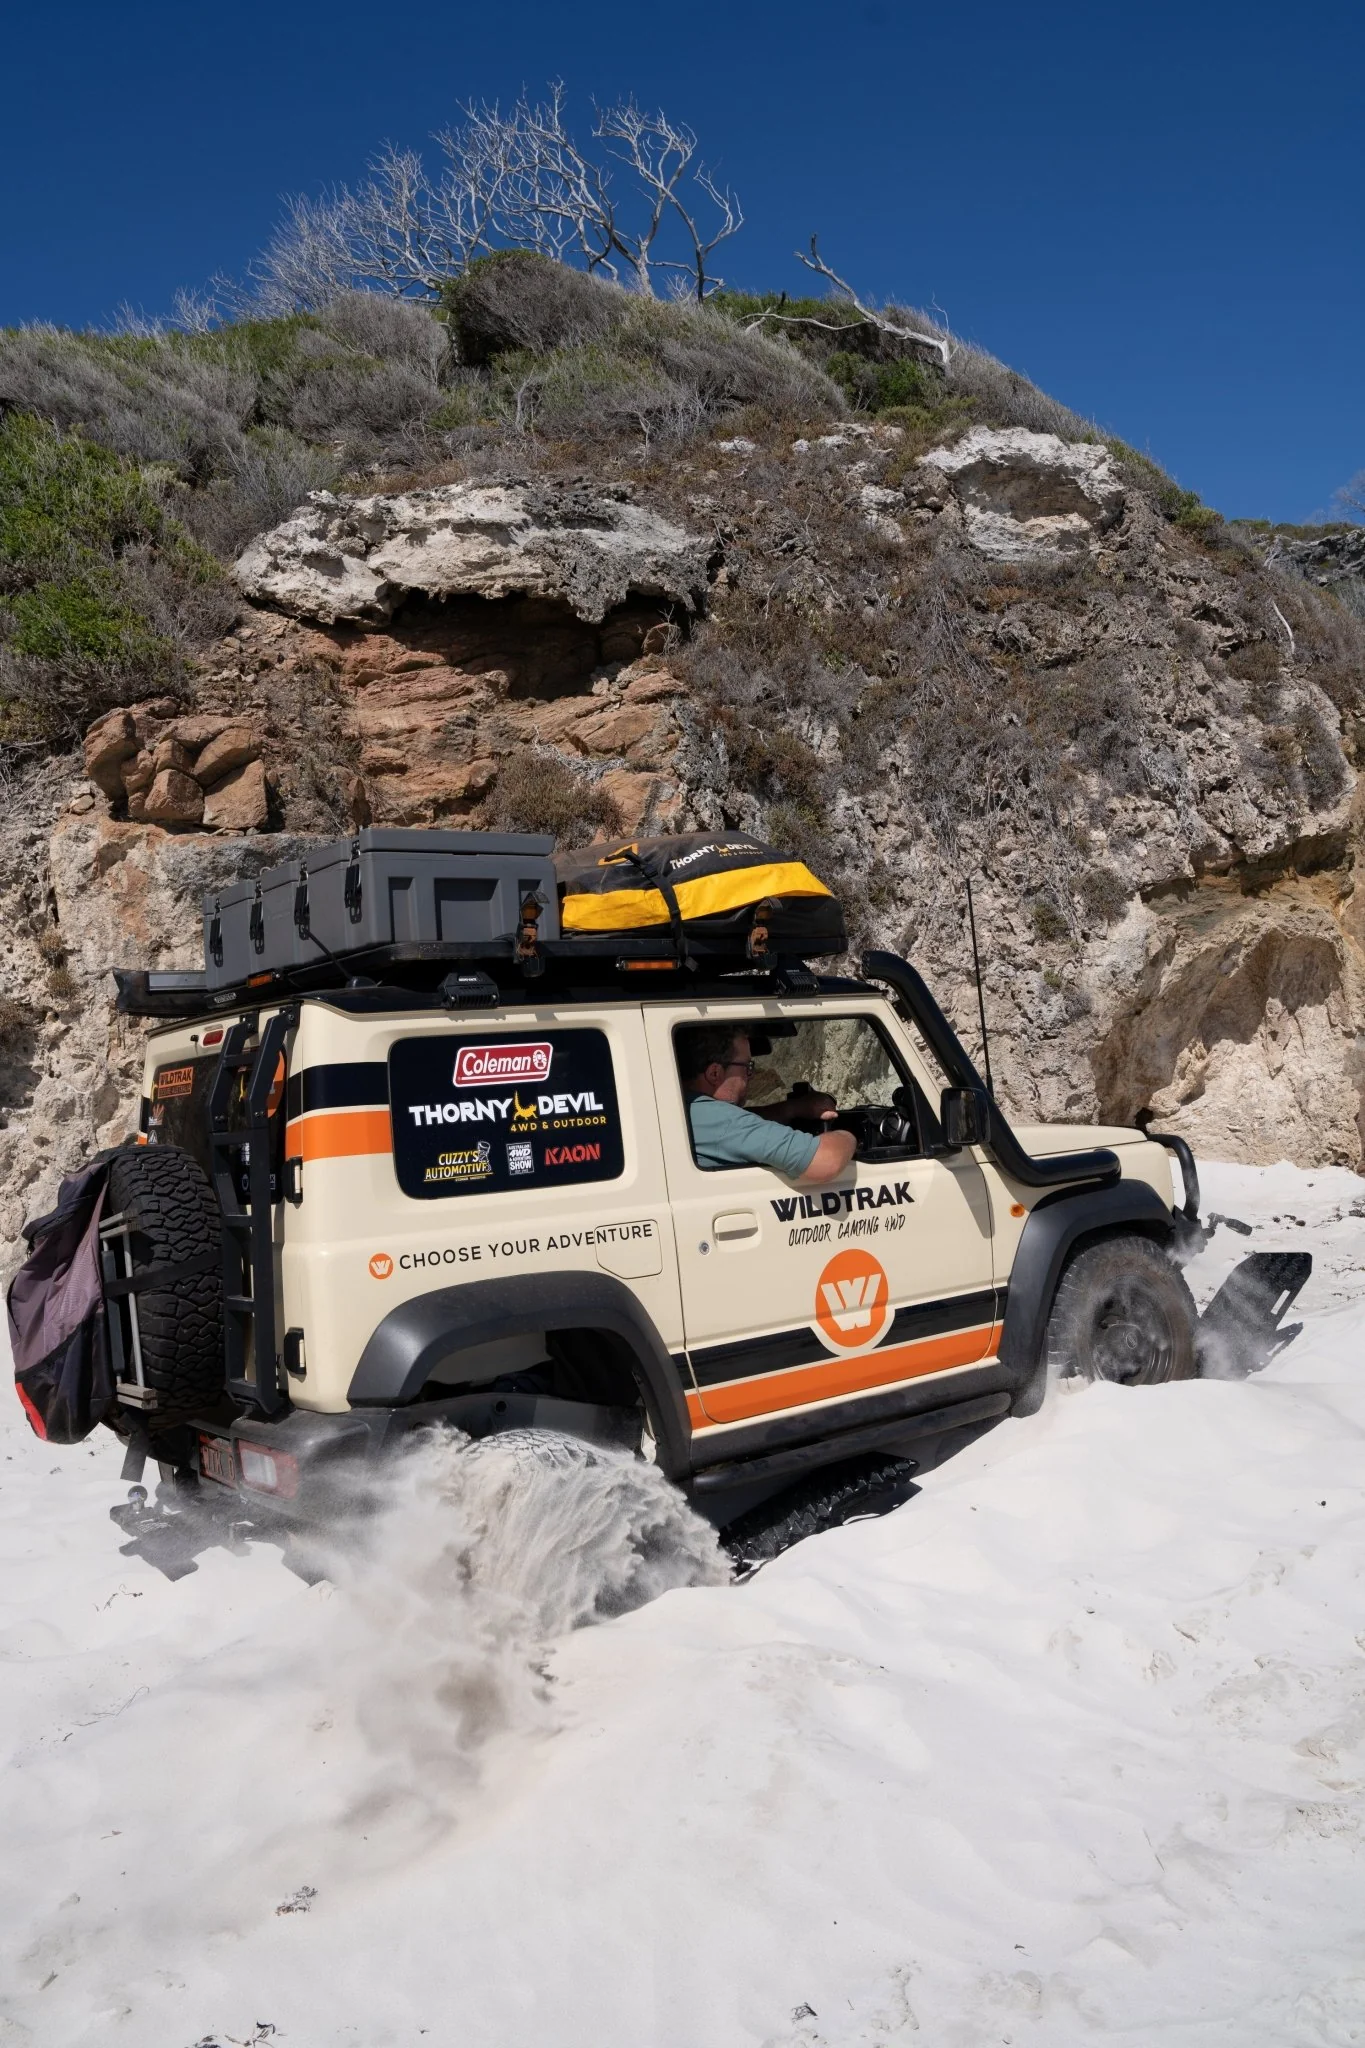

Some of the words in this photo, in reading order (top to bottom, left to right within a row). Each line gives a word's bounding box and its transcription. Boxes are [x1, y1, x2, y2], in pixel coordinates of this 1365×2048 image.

[670, 845, 715, 870] THORNY
[462, 1051, 531, 1076] Coleman
[408, 1097, 513, 1126] THORNY
[537, 1091, 604, 1115] DEVIL
[510, 1122, 537, 1133] 4WD
[542, 1121, 549, 1130] &
[553, 1116, 607, 1129] OUTDOOR
[438, 1149, 479, 1166] CUZZY'S
[510, 1160, 532, 1171] SHOW
[545, 1143, 600, 1165] KAON
[770, 1181, 915, 1222] WILDTRAK
[788, 1223, 832, 1247] OUTDOOR
[838, 1216, 879, 1240] CAMPING
[884, 1213, 906, 1233] 4WD
[399, 1246, 482, 1270] CHOOSE
[488, 1238, 541, 1258] YOUR
[546, 1223, 653, 1251] ADVENTURE
